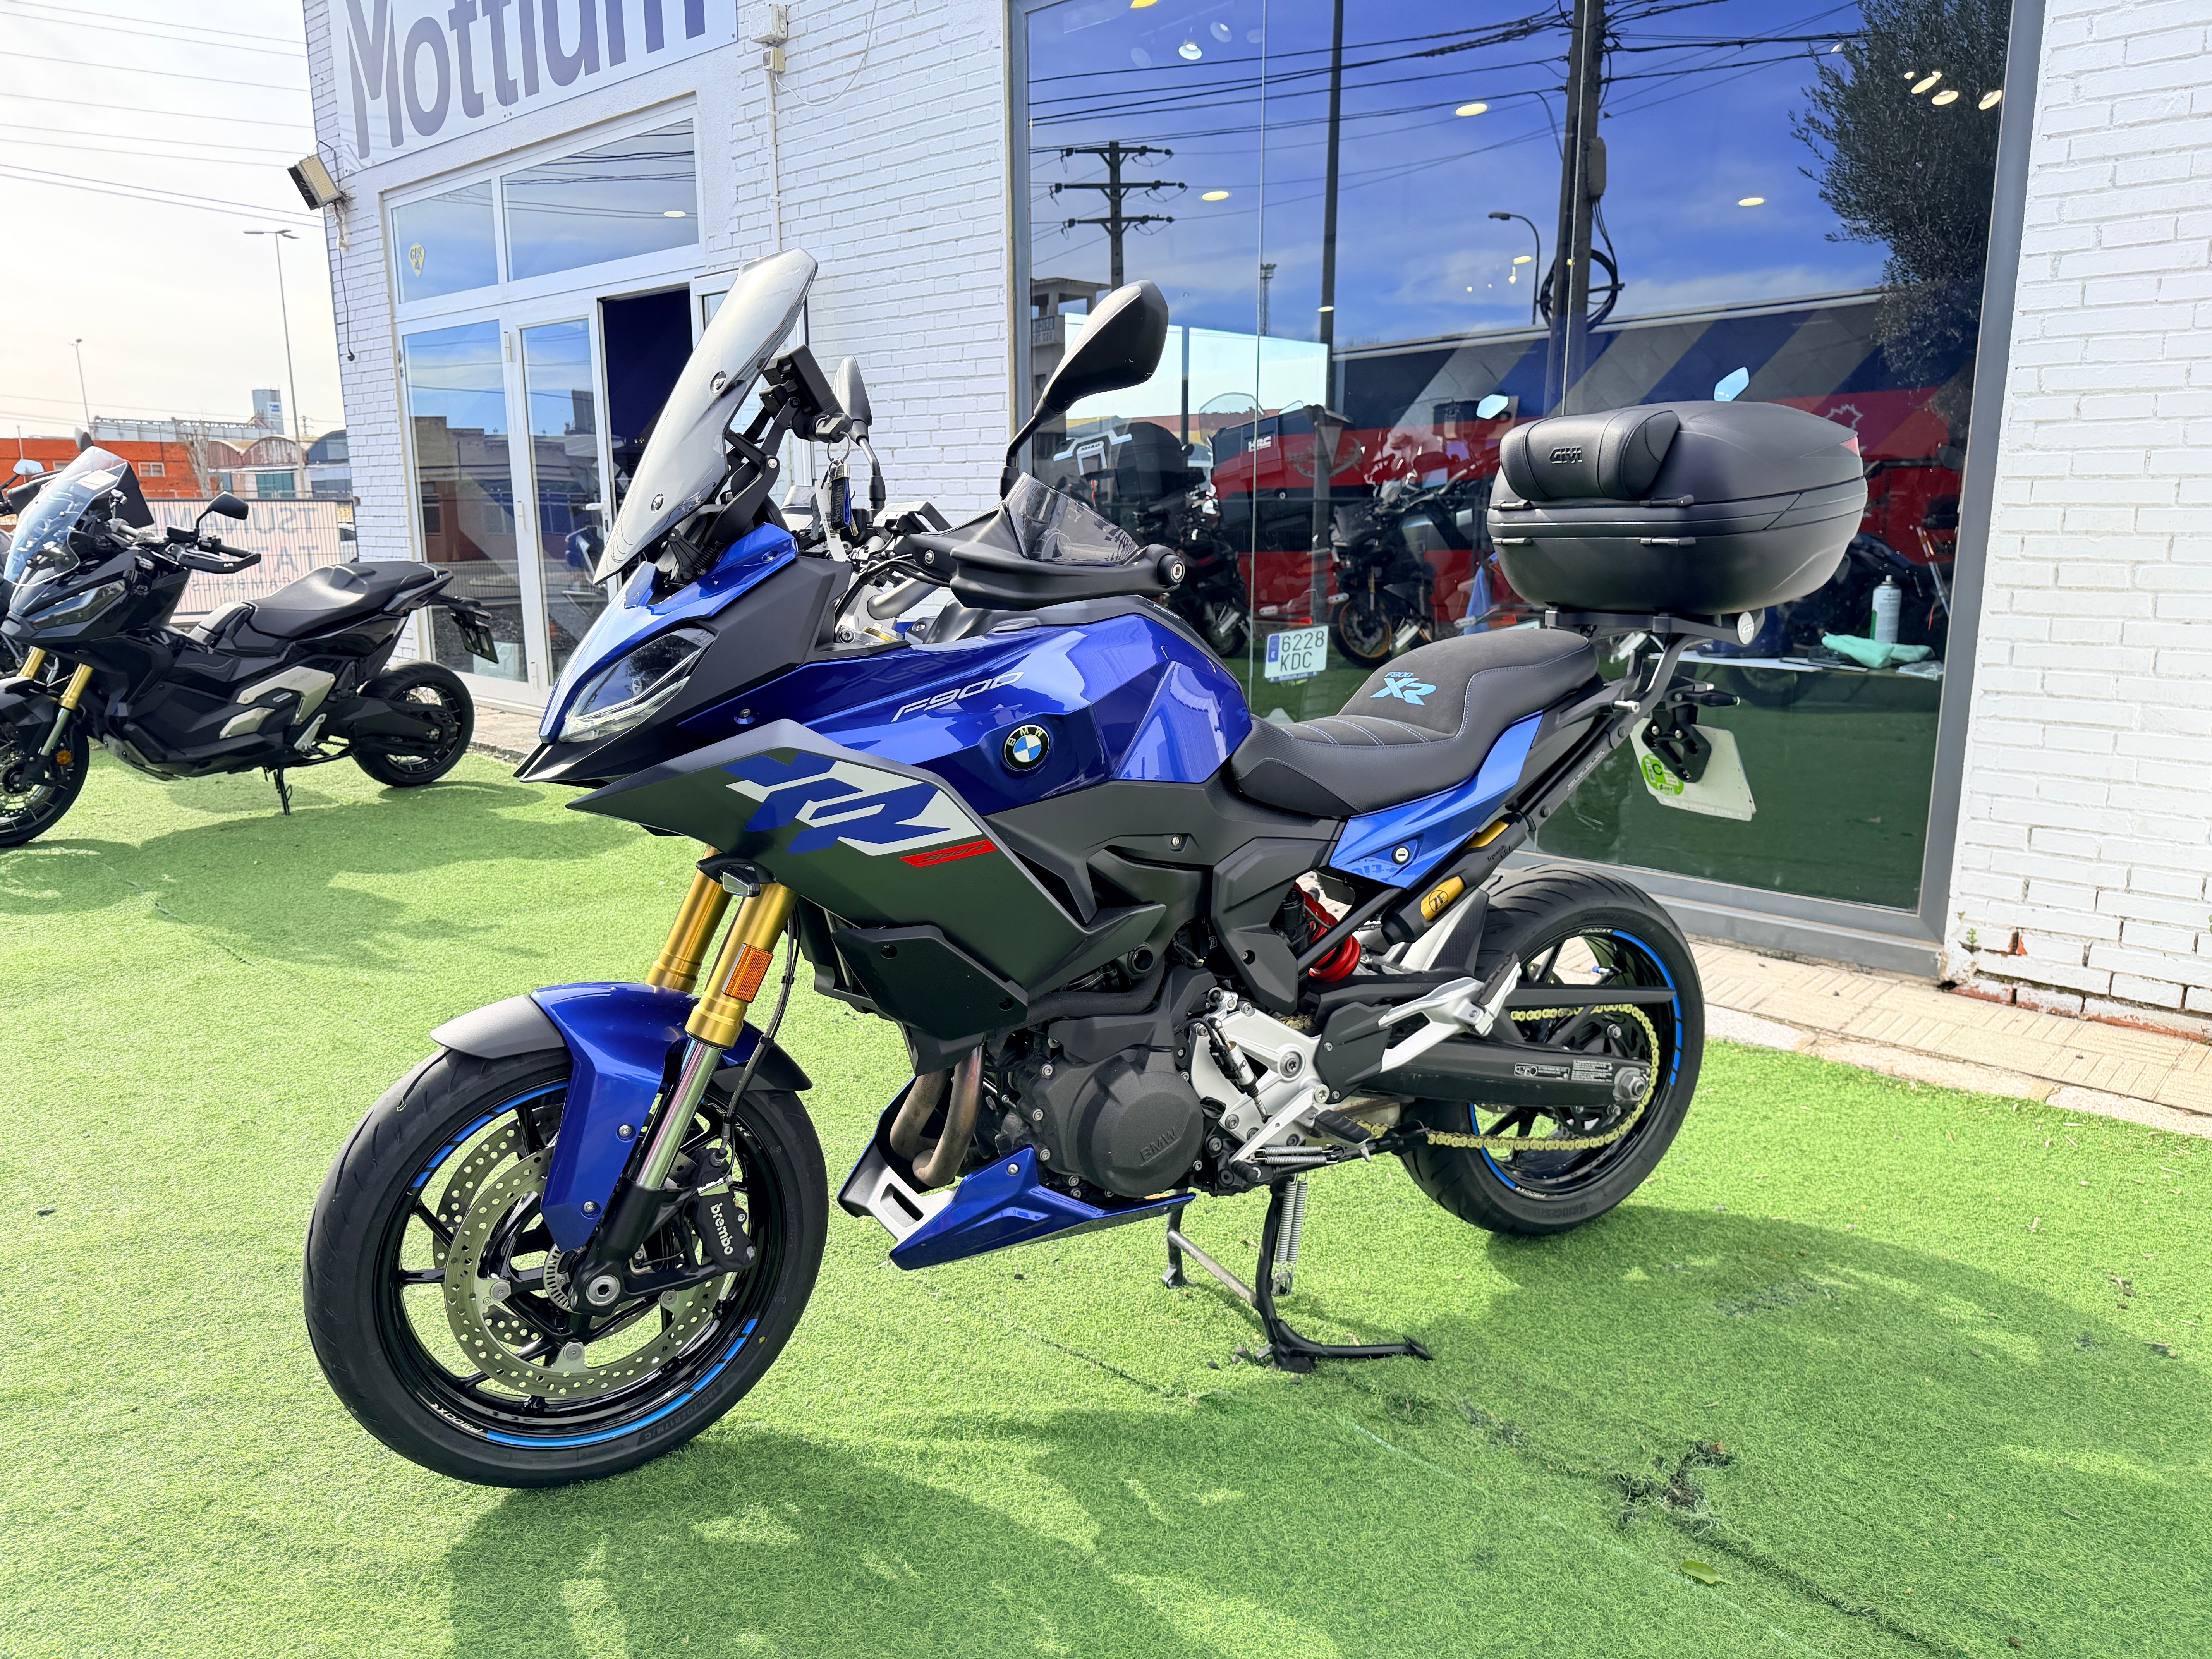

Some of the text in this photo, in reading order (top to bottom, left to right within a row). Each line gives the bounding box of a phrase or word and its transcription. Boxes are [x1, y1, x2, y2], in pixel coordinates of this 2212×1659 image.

[410, 247, 422, 260] GPR
[1549, 446, 1582, 464] GIVI
[833, 485, 843, 523] Mottium
[1282, 631, 1324, 652] 6228
[1280, 651, 1312, 672] KDC
[891, 672, 1024, 723] F900
[1370, 678, 1437, 706] XR
[1007, 727, 1045, 747] BMW
[917, 842, 987, 864] Sport
[1430, 891, 1446, 911] ZF
[1140, 1127, 1175, 1161] BMW
[710, 1202, 734, 1255] brembo
[430, 1403, 483, 1433] F900XR
